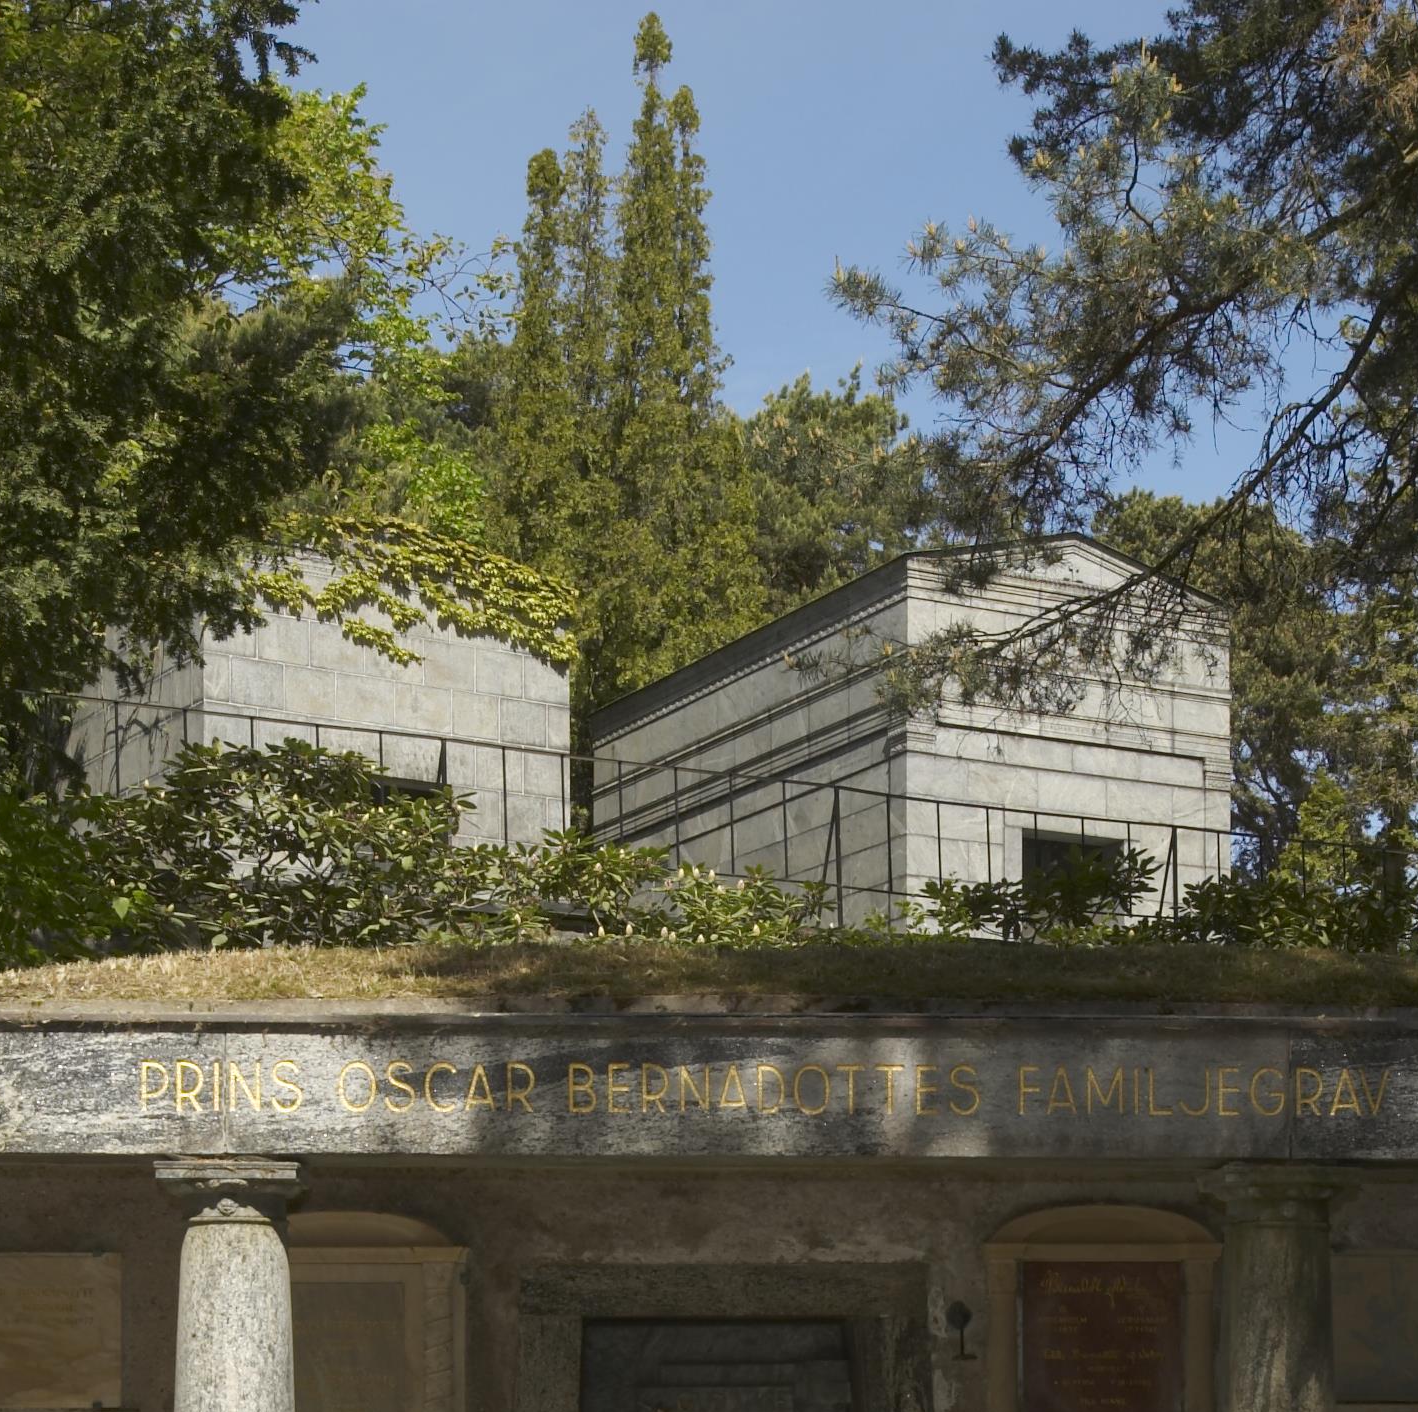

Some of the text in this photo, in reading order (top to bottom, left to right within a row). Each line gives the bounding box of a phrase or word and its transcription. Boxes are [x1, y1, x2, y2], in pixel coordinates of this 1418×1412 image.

[139, 1060, 1392, 1118] PRINS OSCAR BERNADOTTES FAMILJEGRAV
